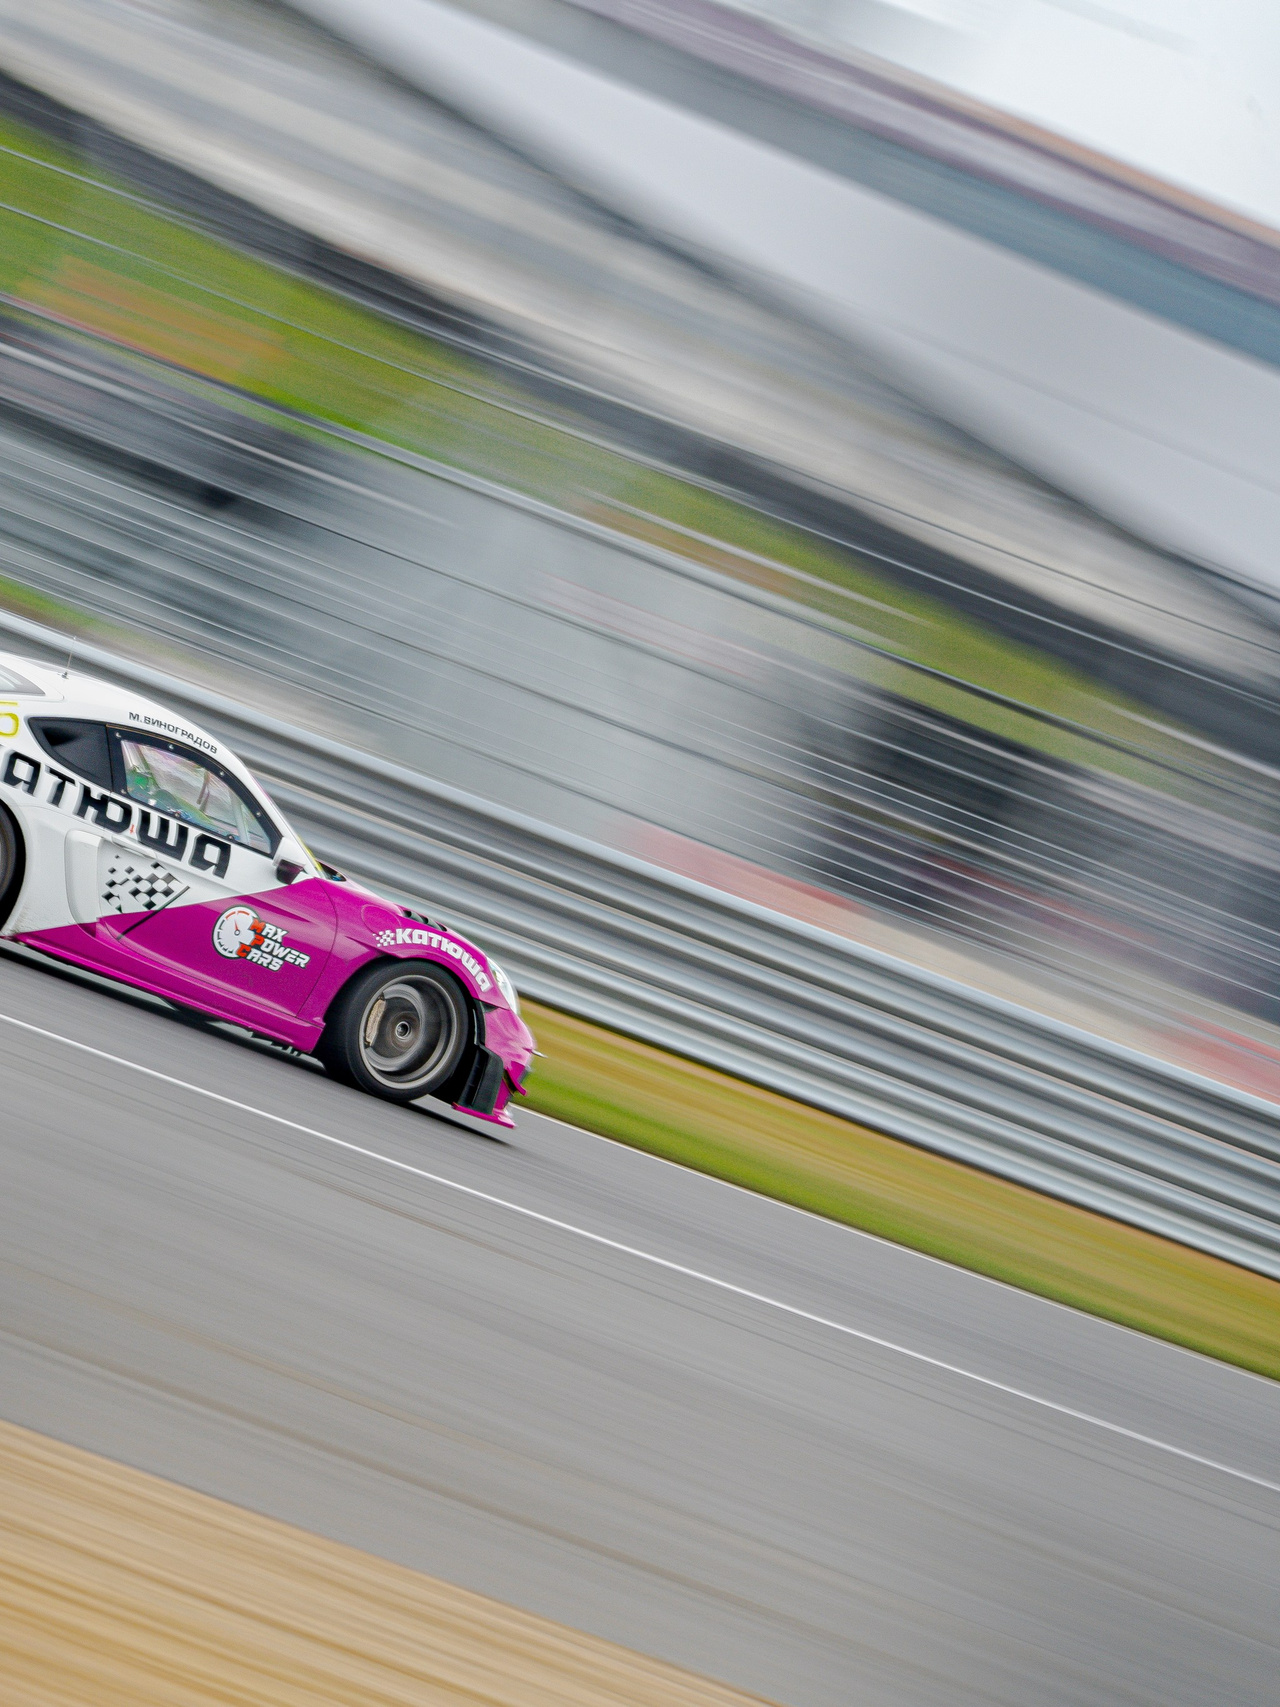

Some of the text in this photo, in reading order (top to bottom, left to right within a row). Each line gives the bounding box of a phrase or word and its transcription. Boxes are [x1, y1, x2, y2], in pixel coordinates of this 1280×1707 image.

[250, 918, 289, 942] MAX
[236, 943, 284, 971] CARS
[250, 934, 311, 968] POWER
